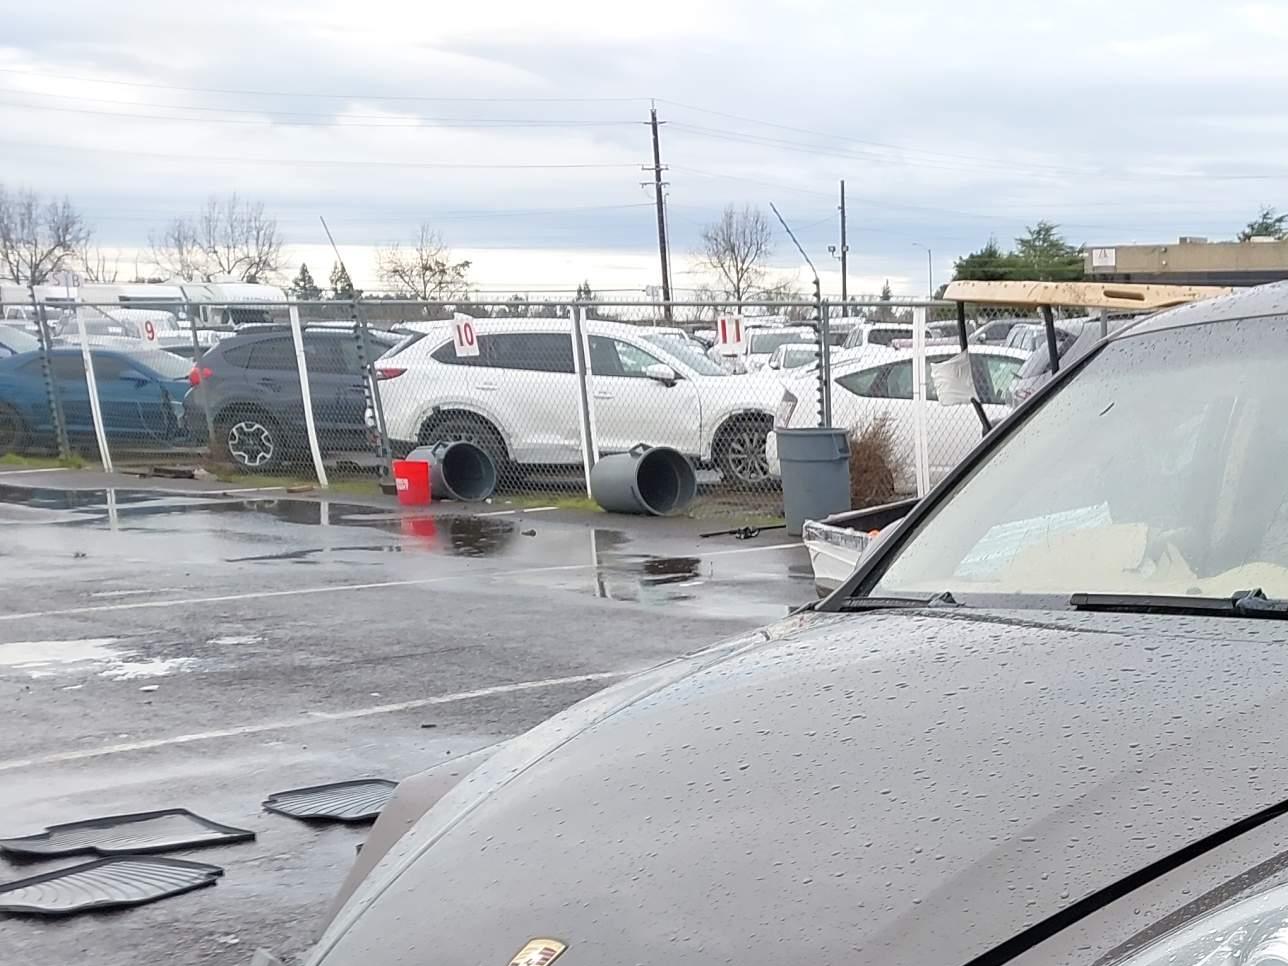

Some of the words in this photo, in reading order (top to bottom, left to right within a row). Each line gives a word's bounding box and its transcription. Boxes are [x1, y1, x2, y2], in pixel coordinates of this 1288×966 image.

[144, 320, 155, 341] 9
[456, 322, 474, 347] 10
[720, 319, 742, 344] 11
